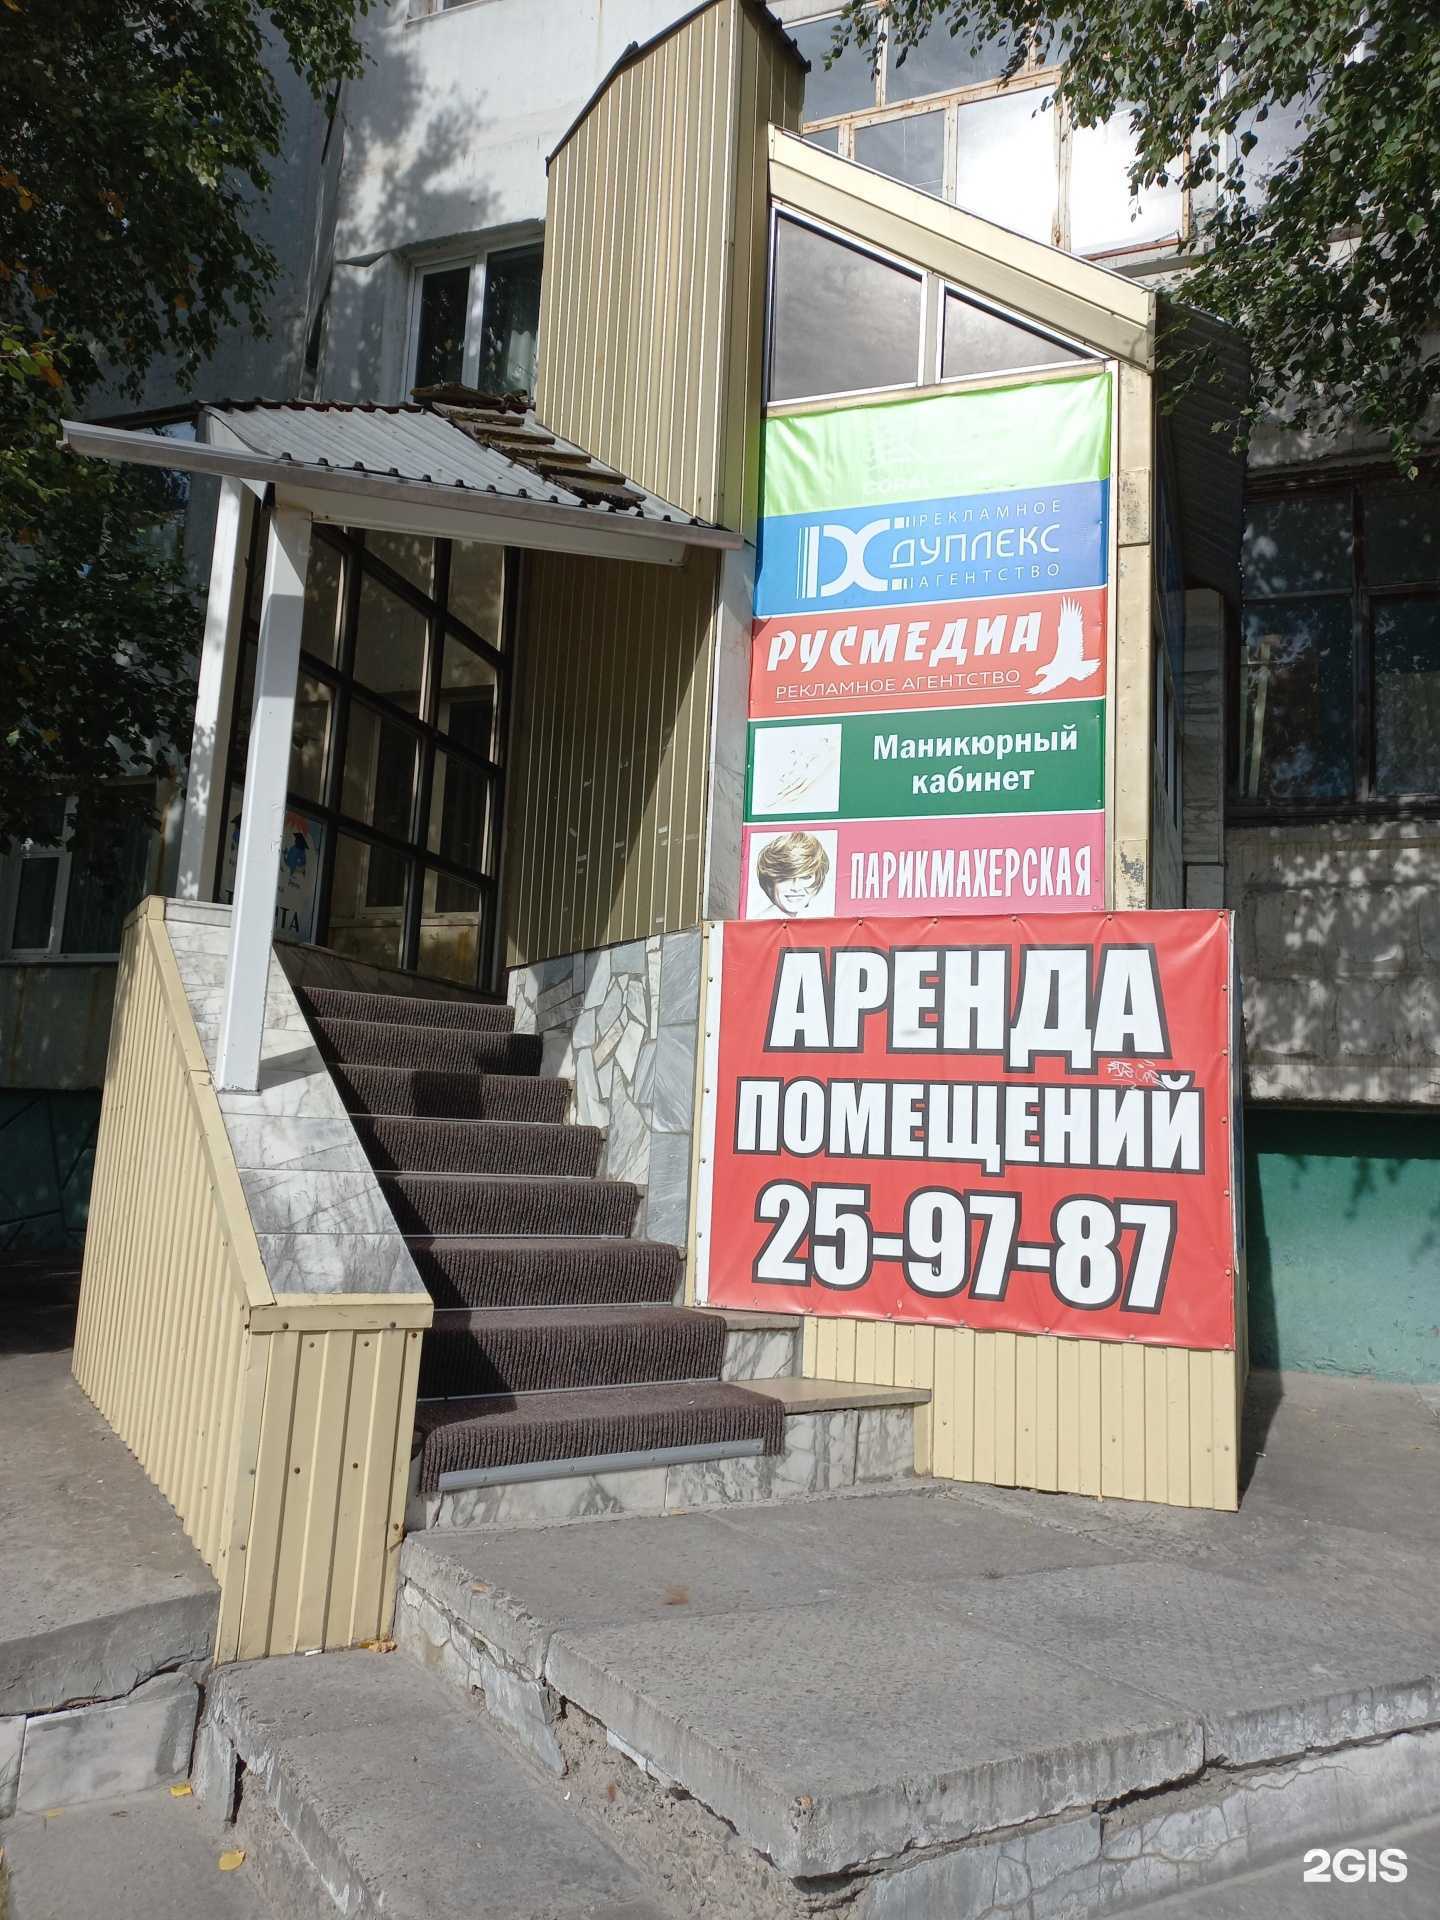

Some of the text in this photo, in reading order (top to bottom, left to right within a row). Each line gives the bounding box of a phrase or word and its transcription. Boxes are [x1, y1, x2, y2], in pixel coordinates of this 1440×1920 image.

[919, 499, 1062, 527] РЕКЛАМНОЕ
[889, 523, 1061, 568] ДУПЛЕКС
[919, 563, 1061, 589] АГЕНТСТВО
[766, 611, 1042, 673] РУСМЕДИА
[775, 670, 1021, 699] РЕКЛАМНОЕ АГЕНТСТВО
[873, 723, 1078, 760] Маникюрный
[912, 765, 1036, 795] кабинет
[850, 845, 1092, 900] ПАРИКМАХЕРСКАЯ
[764, 944, 1172, 1074] АРЕНДА
[734, 1071, 1205, 1176] ПОМЕЩЕНИЙ
[752, 1178, 1178, 1314] 25-97-87
